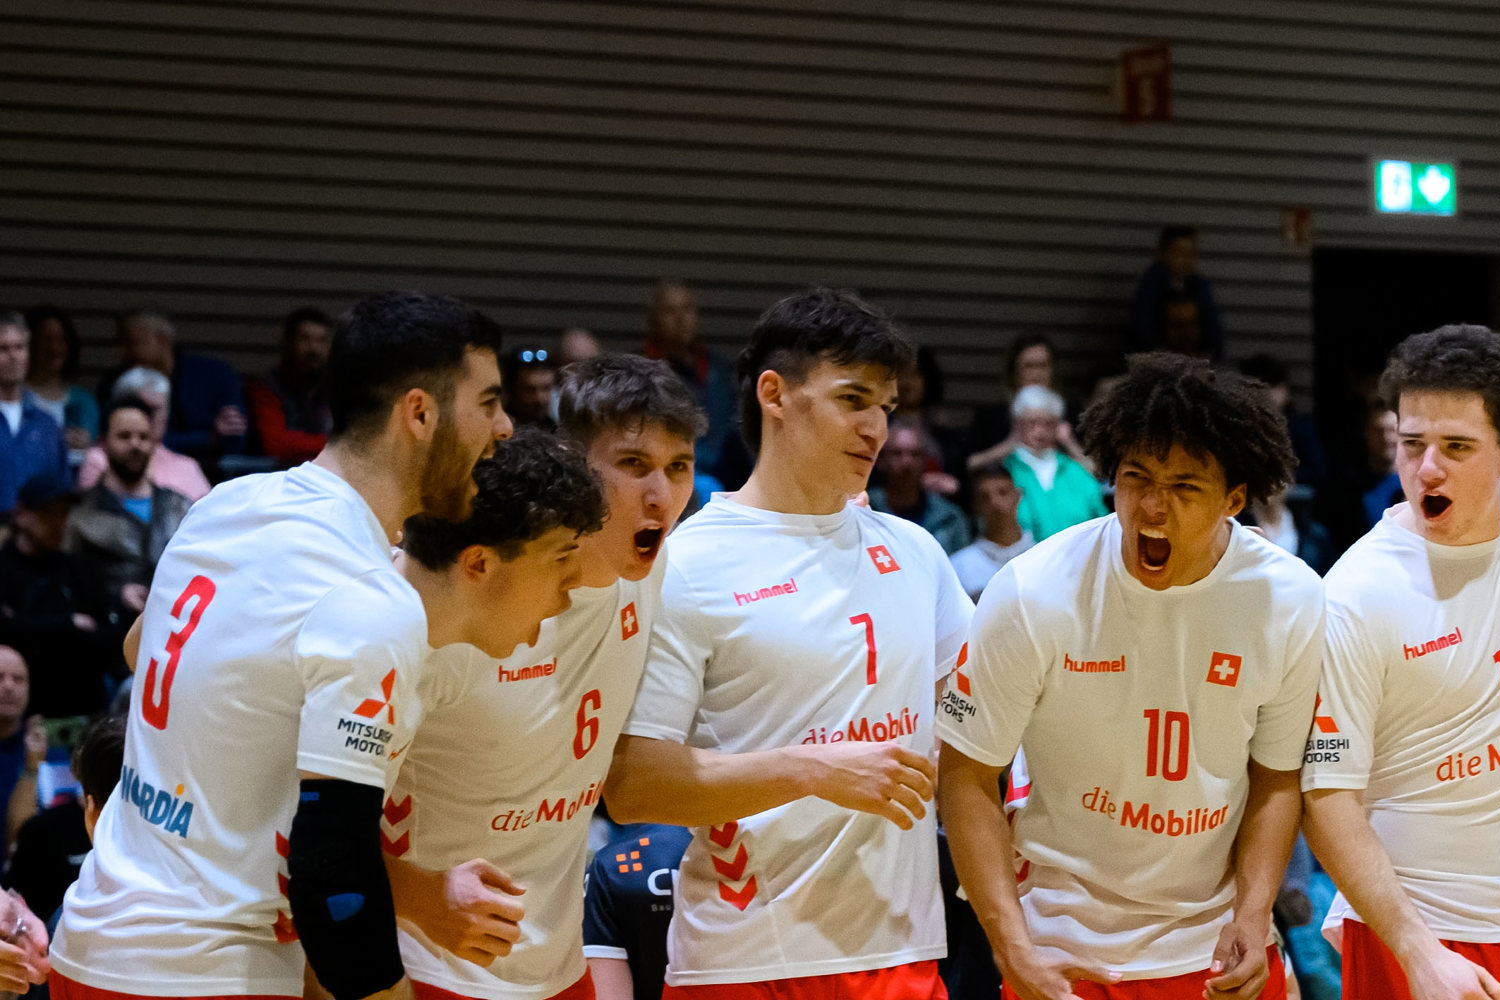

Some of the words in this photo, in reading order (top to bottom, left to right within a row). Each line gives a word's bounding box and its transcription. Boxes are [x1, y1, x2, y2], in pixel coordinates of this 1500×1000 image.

[733, 577, 799, 607] hummel
[142, 575, 216, 730] 3
[849, 612, 877, 685] 7
[1402, 627, 1463, 660] hummel
[498, 656, 557, 683] hummel
[1064, 653, 1126, 673] hummel
[573, 689, 602, 760] 6
[1143, 708, 1190, 782] 10
[1436, 753, 1482, 782] die
[491, 809, 534, 832] die
[1081, 786, 1117, 820] die
[1120, 801, 1229, 837] Mobiliar
